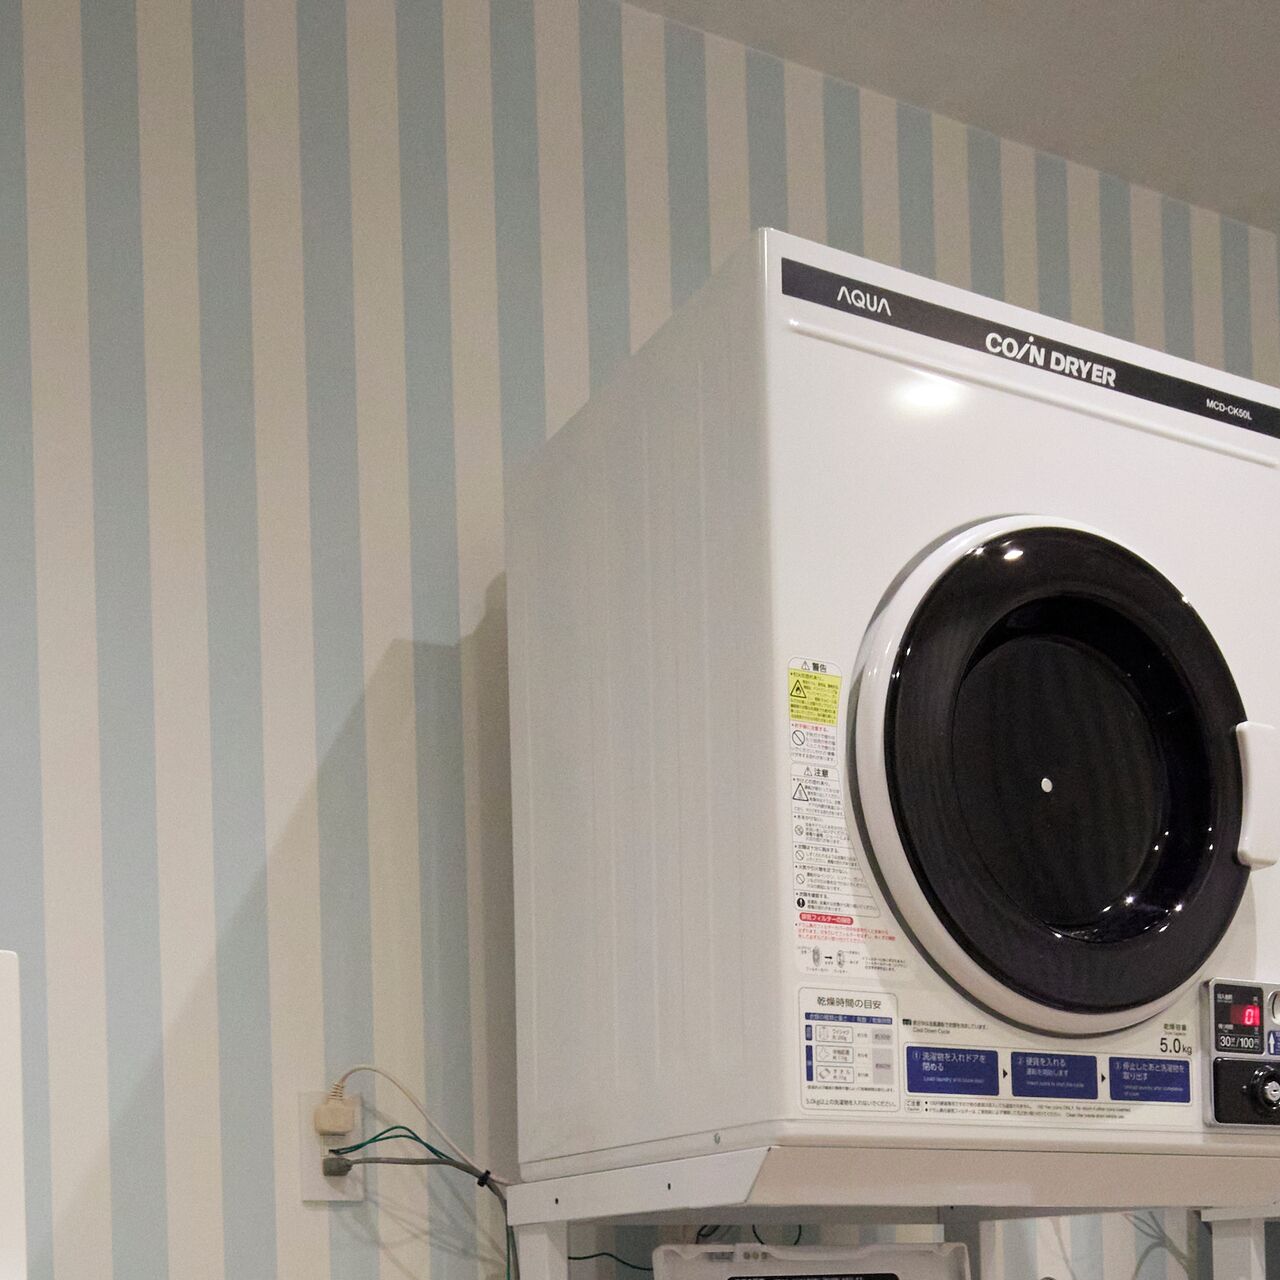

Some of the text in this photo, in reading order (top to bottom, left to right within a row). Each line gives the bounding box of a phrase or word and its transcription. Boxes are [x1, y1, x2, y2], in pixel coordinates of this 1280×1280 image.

[837, 285, 892, 316] AQUA
[985, 332, 1117, 387] COIN DRYER
[1206, 398, 1253, 421] MCD-CK50L
[817, 996, 882, 1010] 乾燥時間の目安
[1244, 1008, 1255, 1025] 0
